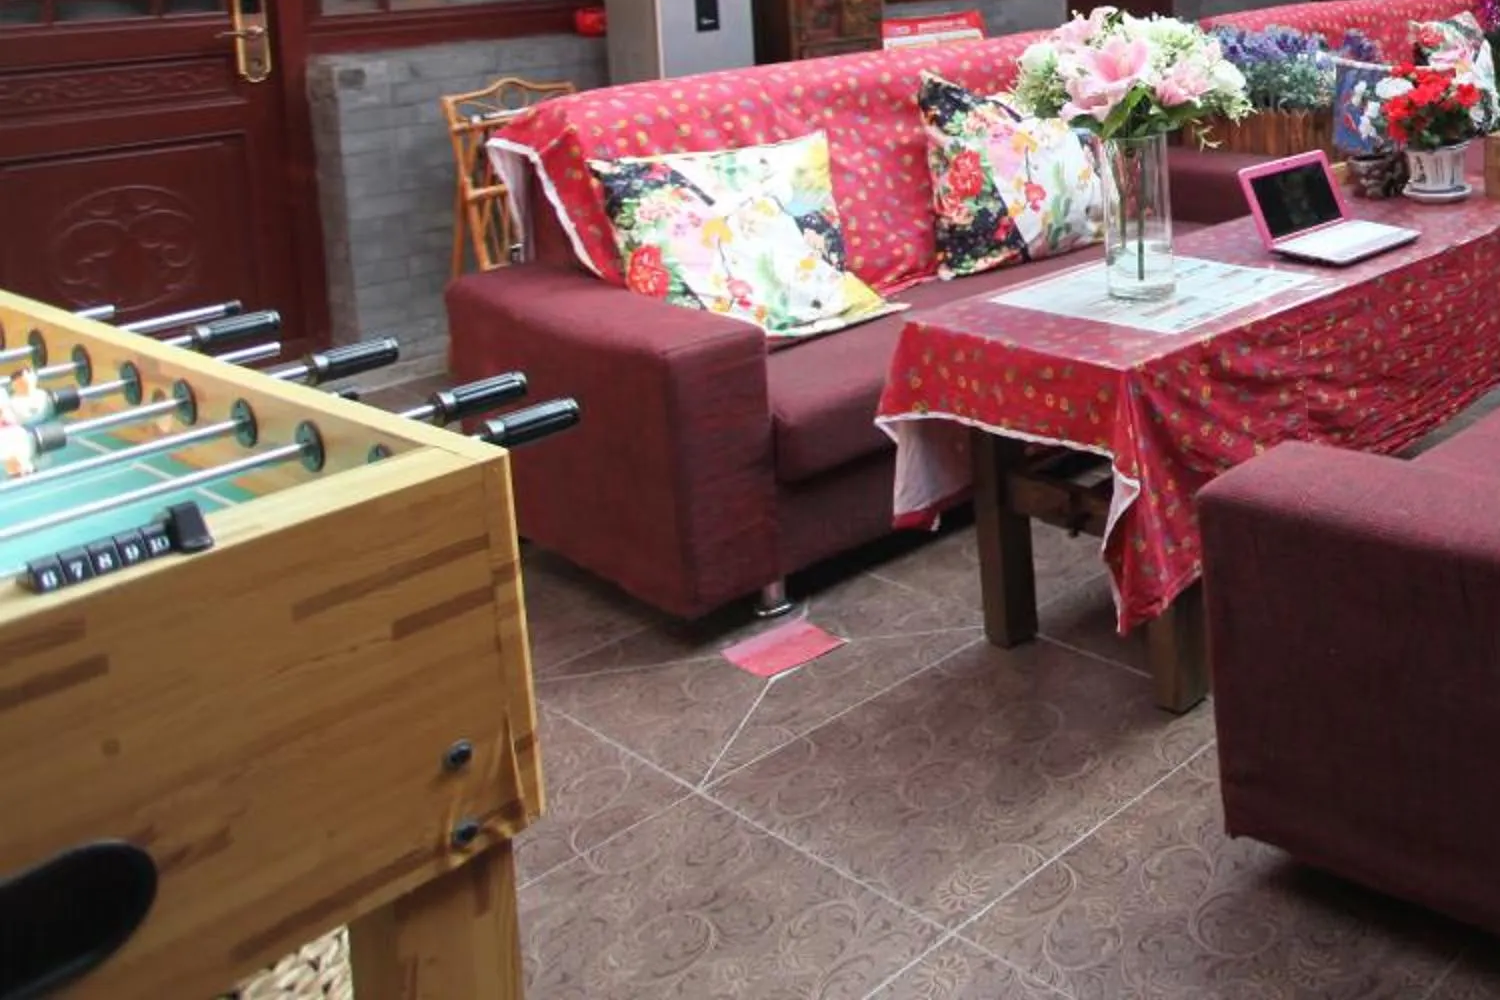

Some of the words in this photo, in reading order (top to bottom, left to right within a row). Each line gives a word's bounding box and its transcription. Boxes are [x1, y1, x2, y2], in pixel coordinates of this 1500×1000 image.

[70, 560, 83, 580] 7
[98, 553, 112, 570] 8
[124, 544, 139, 562] 9
[151, 536, 170, 554] 10
